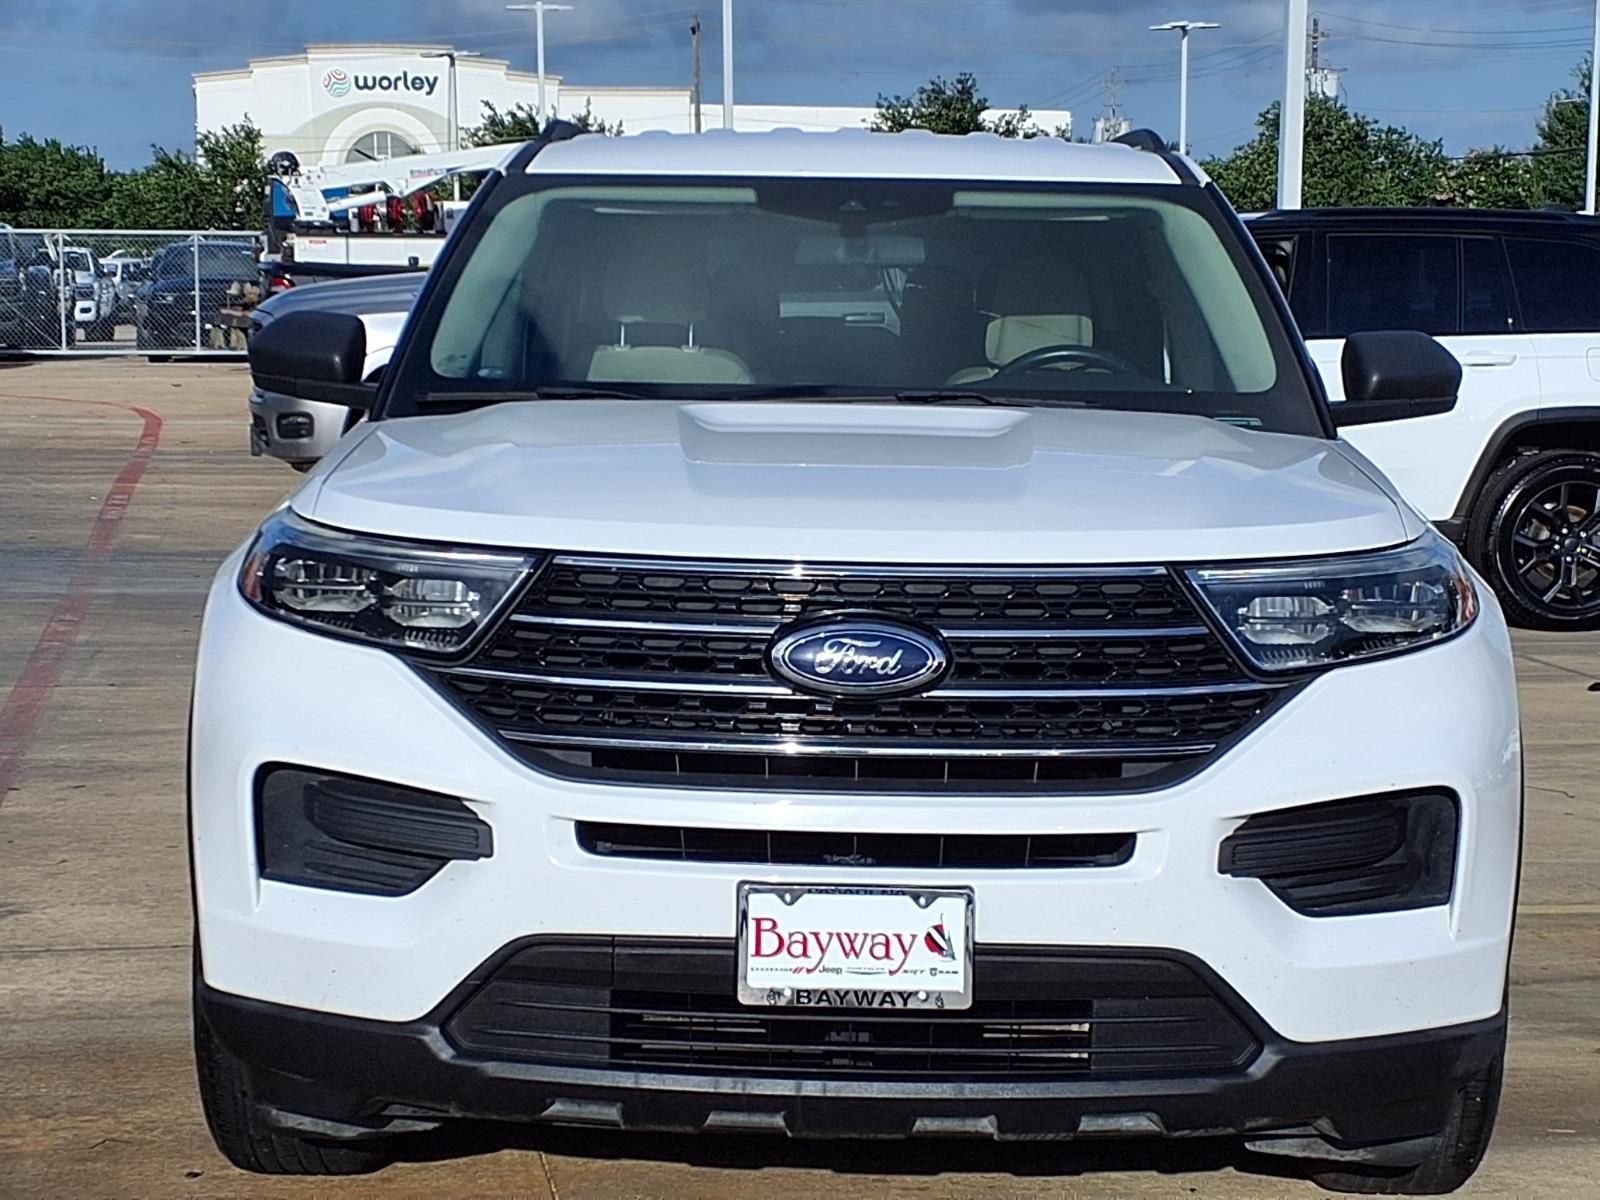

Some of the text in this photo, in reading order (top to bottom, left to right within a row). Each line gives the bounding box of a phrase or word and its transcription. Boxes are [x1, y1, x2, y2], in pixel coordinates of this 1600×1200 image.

[353, 70, 439, 96] worley
[813, 637, 904, 675] Ford
[750, 917, 919, 976] Bayway
[818, 965, 843, 976] Jeep
[795, 989, 915, 1008] BAYWAY
